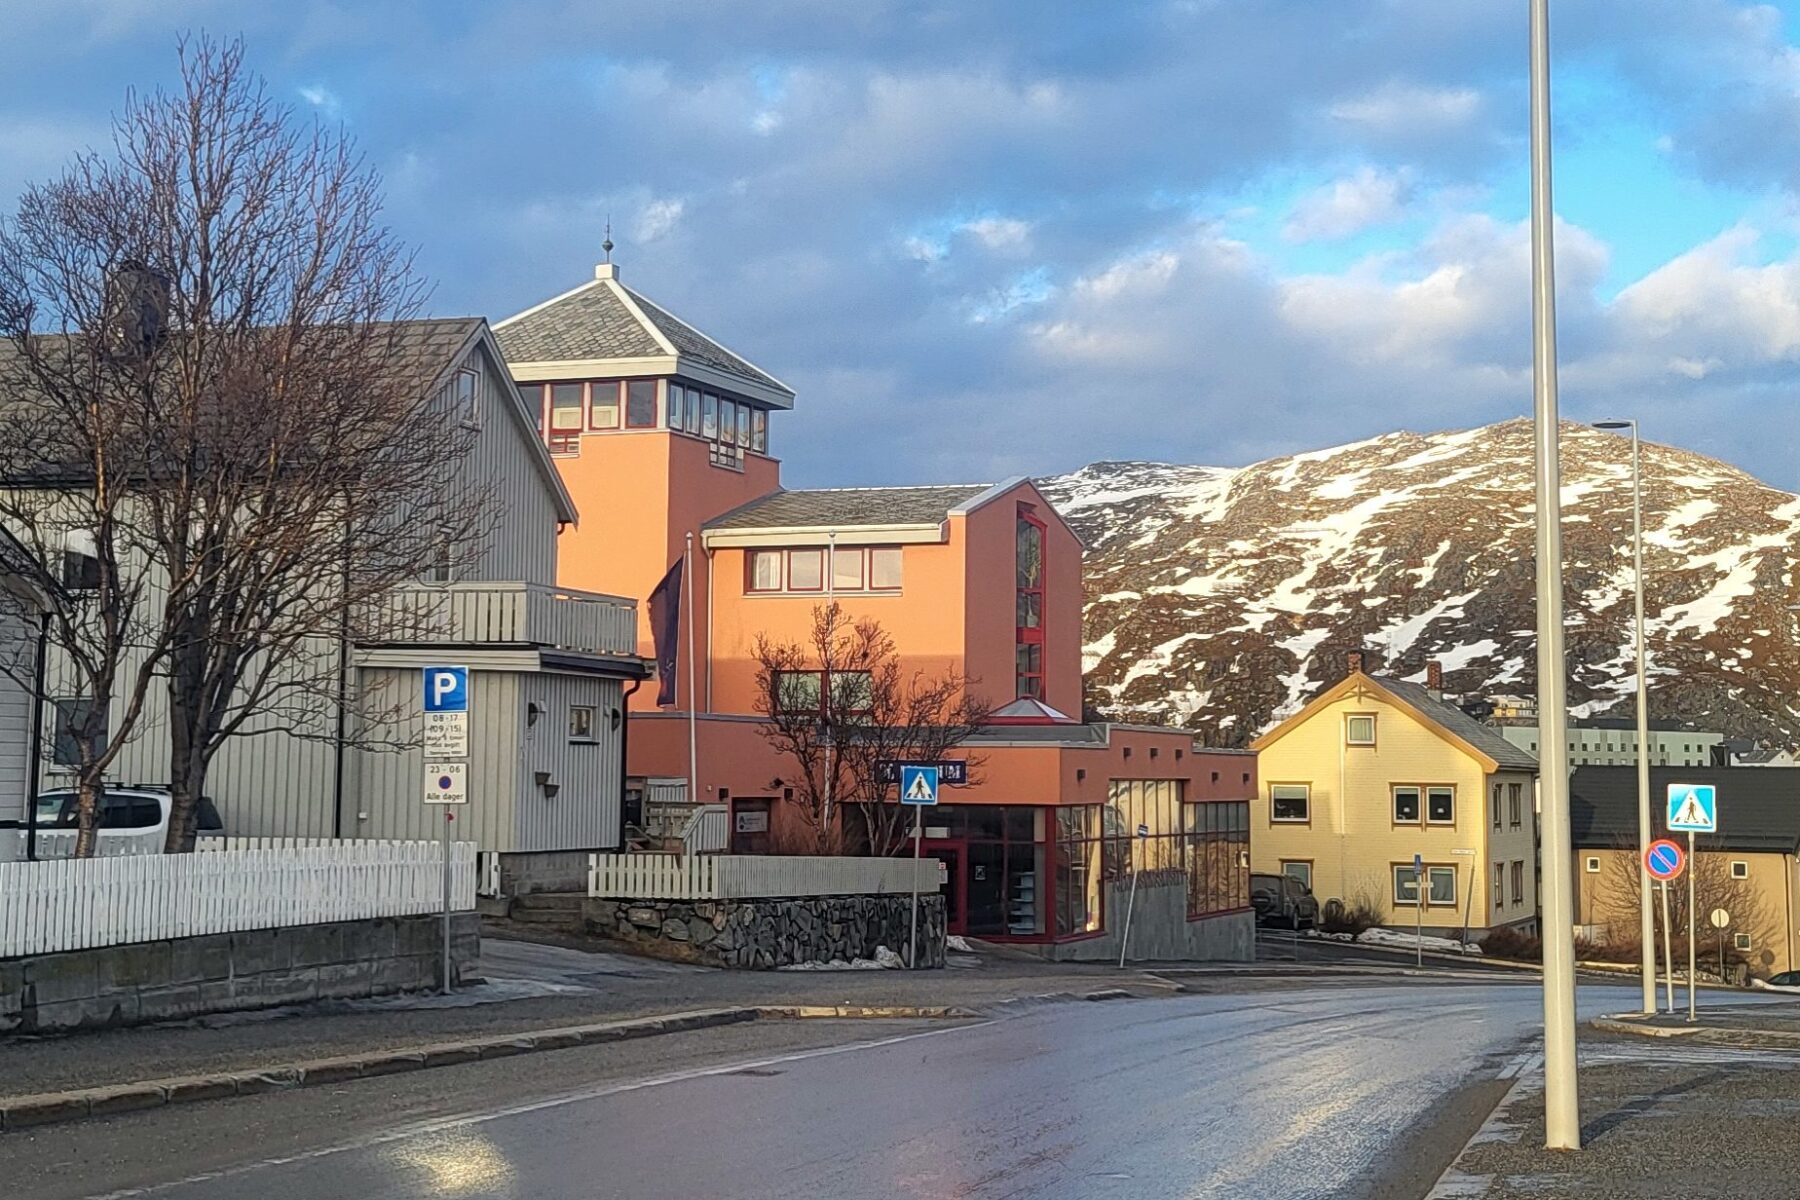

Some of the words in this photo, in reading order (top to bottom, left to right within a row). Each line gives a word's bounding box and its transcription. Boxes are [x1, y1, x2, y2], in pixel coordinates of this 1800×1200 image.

[434, 672, 457, 706] P
[426, 792, 440, 800] Alle
[442, 792, 464, 802] dager
